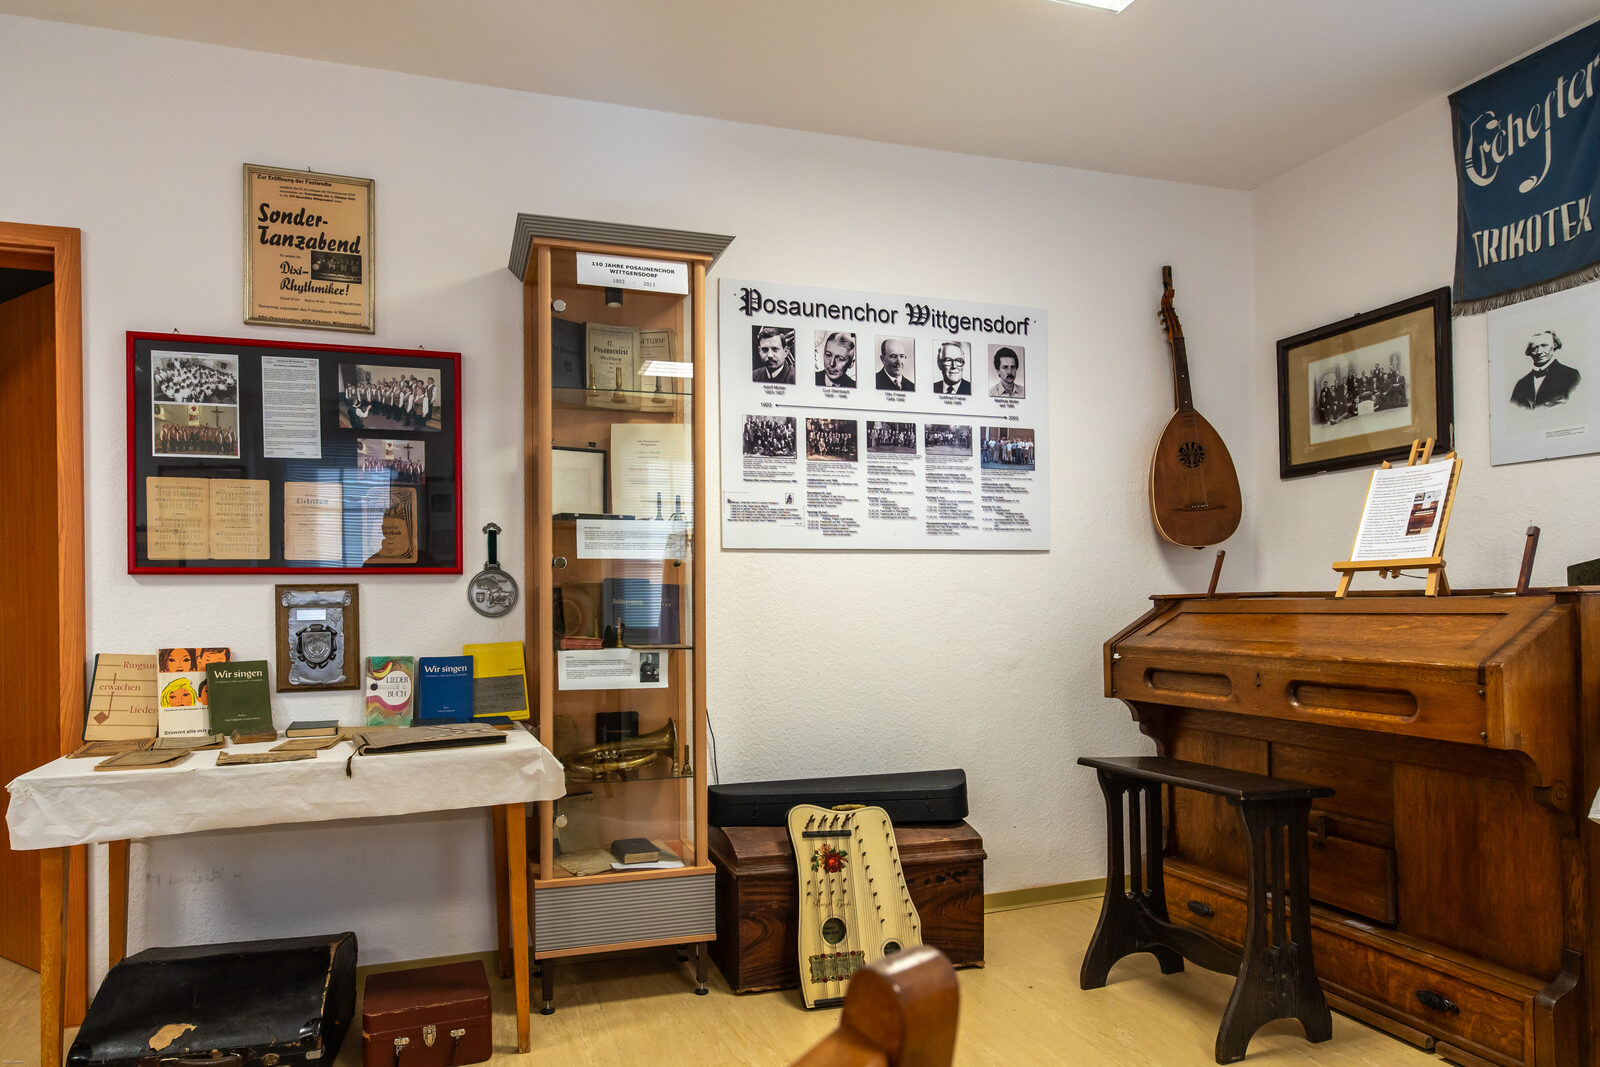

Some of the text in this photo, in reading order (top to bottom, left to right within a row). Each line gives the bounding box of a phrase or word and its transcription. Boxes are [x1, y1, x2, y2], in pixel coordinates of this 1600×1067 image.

[268, 175, 294, 184] Eröffnung
[258, 203, 328, 228] Sonder-
[1472, 194, 1593, 268] TRIKOTEX
[258, 225, 361, 254] Tanzabend
[280, 261, 309, 275] Dixi-
[610, 269, 658, 278] WITTGENSDORF
[626, 265, 675, 274] POSAUNENCHOR
[280, 278, 349, 296] Rhythmiker!
[738, 288, 1030, 336] Posaunenchor Wittgensdorf
[214, 670, 262, 679] Wir singen
[442, 665, 467, 674] singen
[99, 683, 141, 692] erwachen
